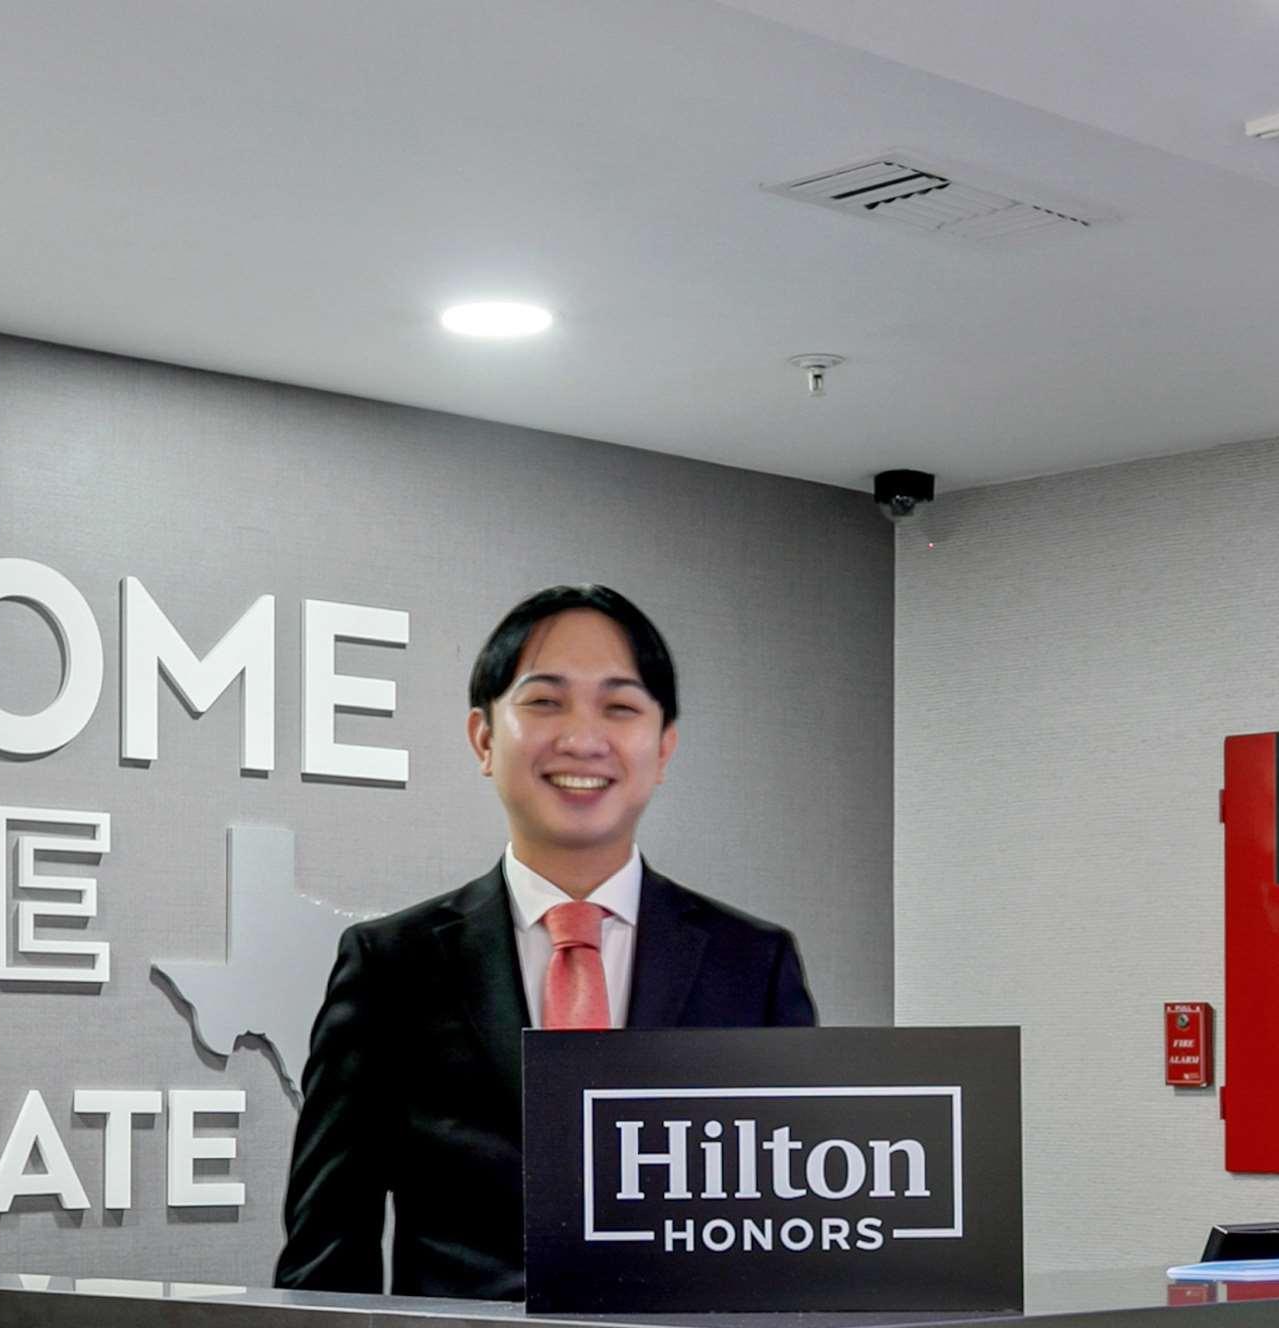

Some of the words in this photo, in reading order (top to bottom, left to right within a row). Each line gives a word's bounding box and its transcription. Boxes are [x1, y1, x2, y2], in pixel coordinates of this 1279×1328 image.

[1173, 1039, 1194, 1048] FIRE
[1169, 1056, 1199, 1064] ALARM
[616, 1119, 931, 1200] Hilton
[665, 1217, 884, 1252] HONORS
